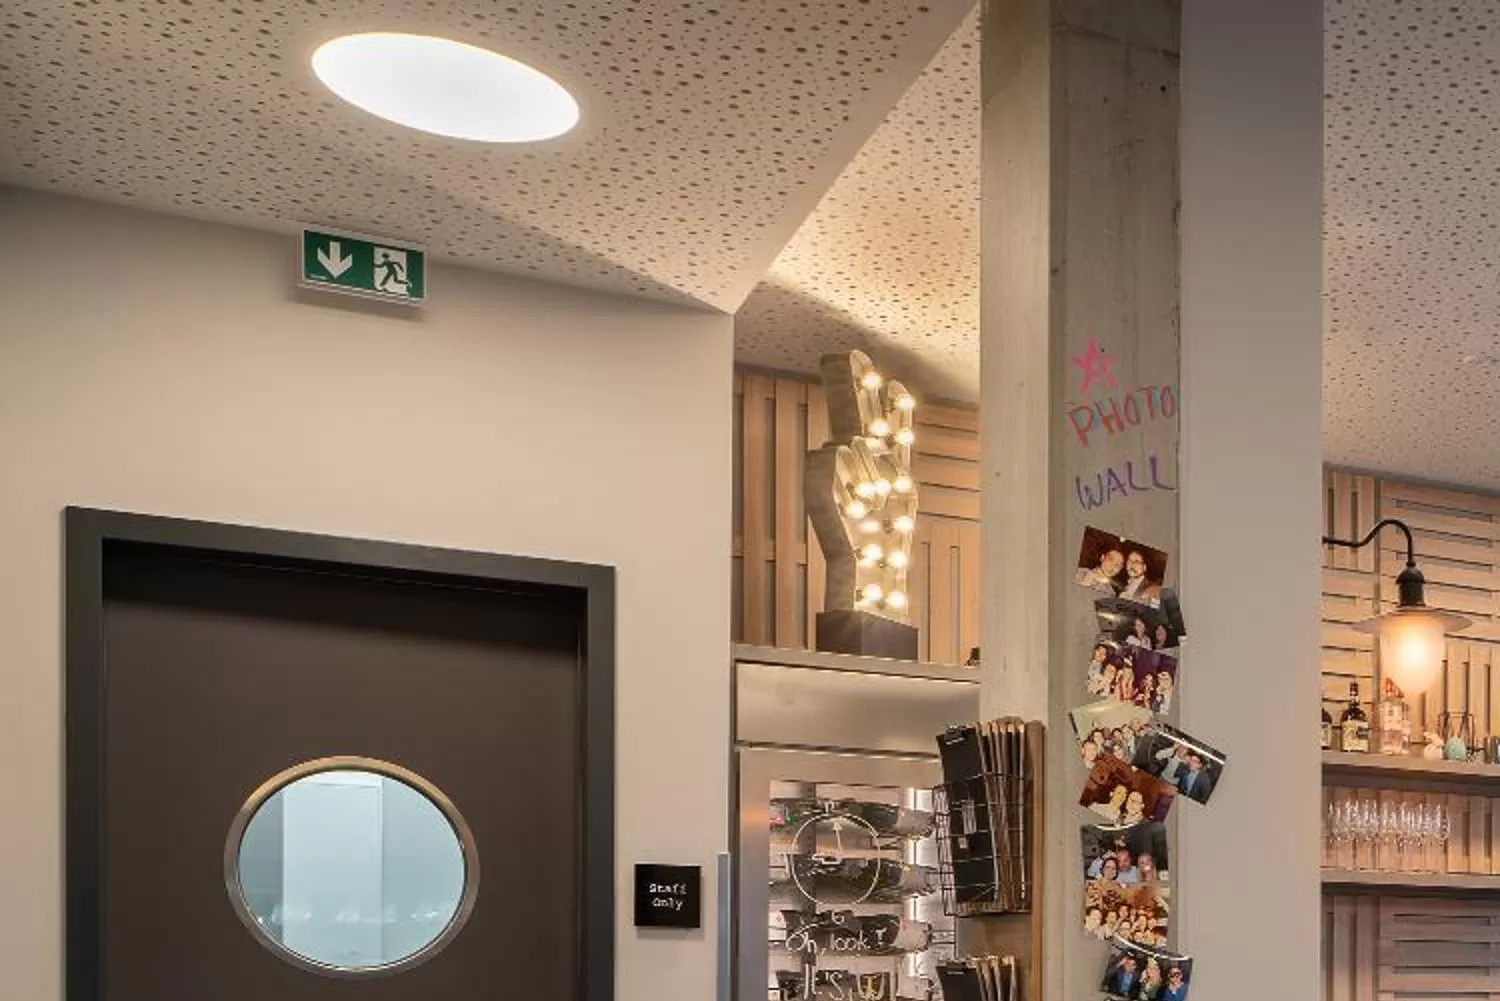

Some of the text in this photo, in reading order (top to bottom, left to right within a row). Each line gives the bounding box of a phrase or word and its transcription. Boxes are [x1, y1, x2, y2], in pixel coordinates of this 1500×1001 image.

[1067, 384, 1176, 448] PHOTO
[1075, 455, 1177, 511] WALL
[648, 883, 688, 895] Staff
